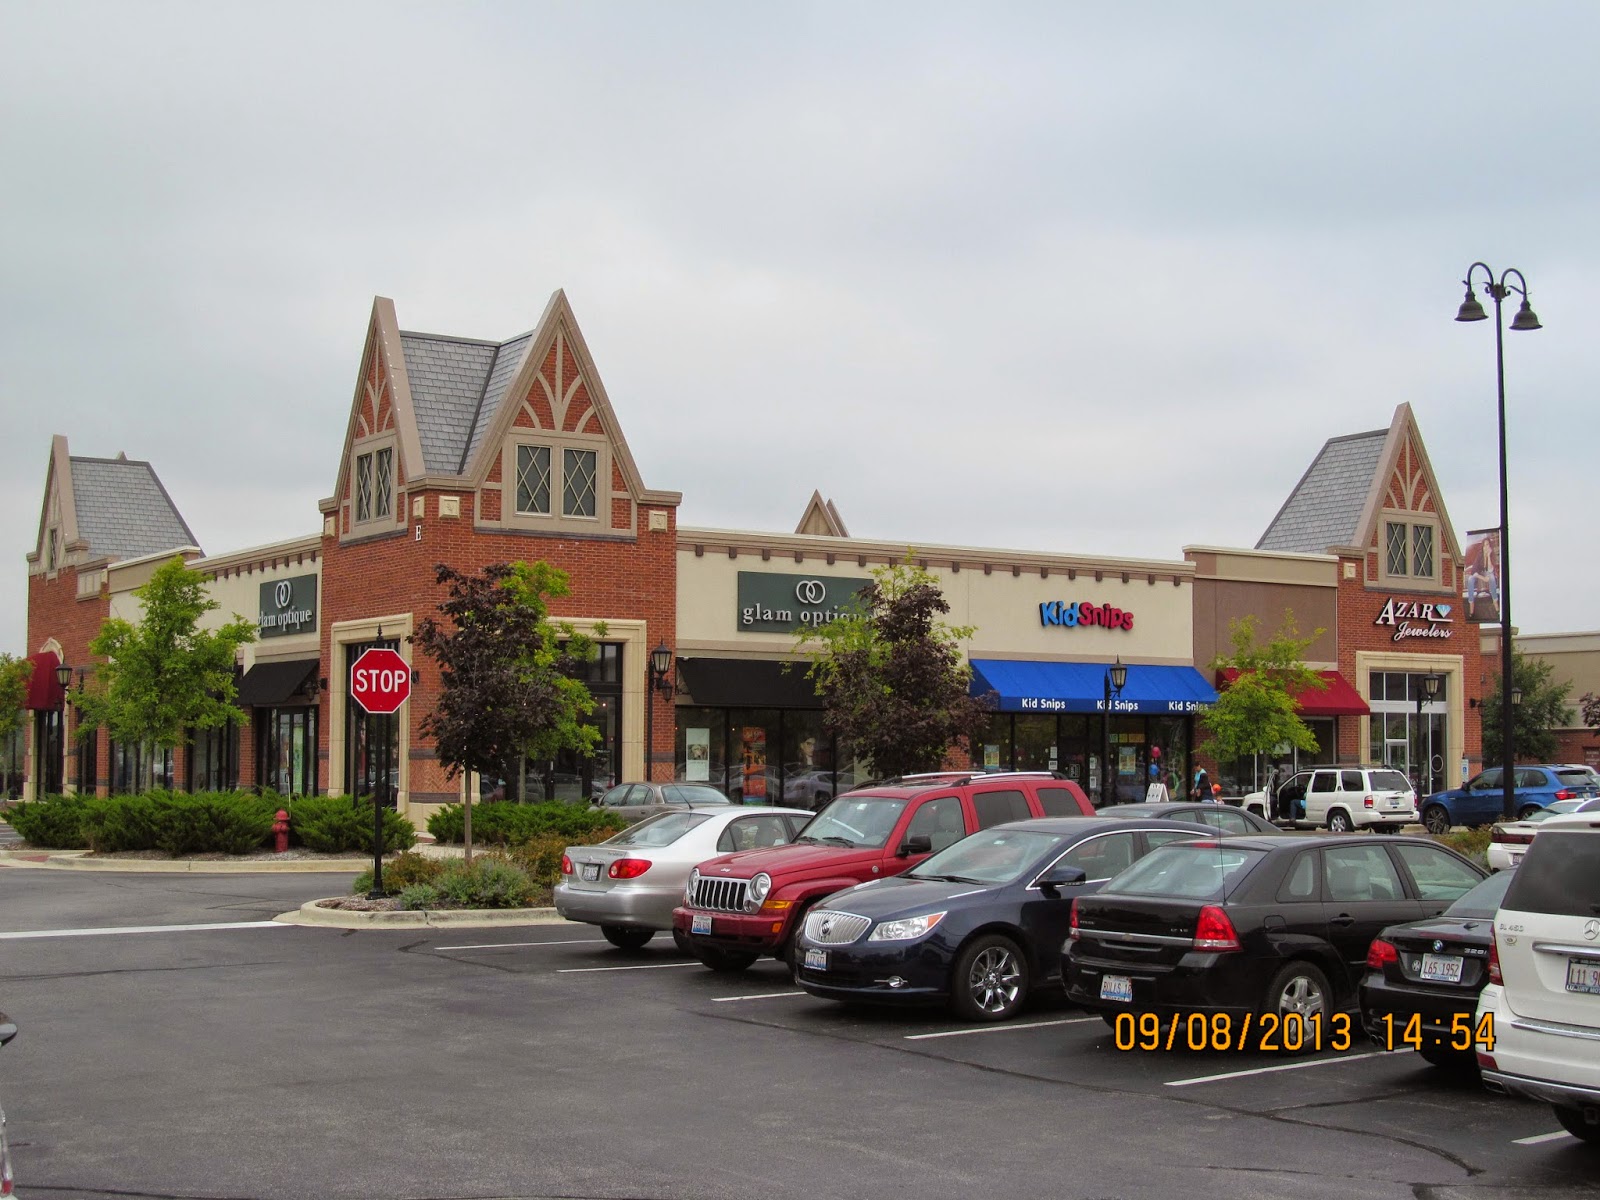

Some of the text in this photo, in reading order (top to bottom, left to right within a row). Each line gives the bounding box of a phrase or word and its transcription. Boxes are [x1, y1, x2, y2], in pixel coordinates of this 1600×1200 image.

[277, 605, 312, 632] optique
[743, 603, 874, 628] glam opti
[1040, 601, 1134, 631] KidSnips
[1393, 621, 1453, 641] Jewelers
[355, 668, 407, 693] STOP
[1021, 697, 1066, 711] Kid Snips
[1114, 700, 1139, 712] Snips
[1168, 700, 1183, 711] Kid
